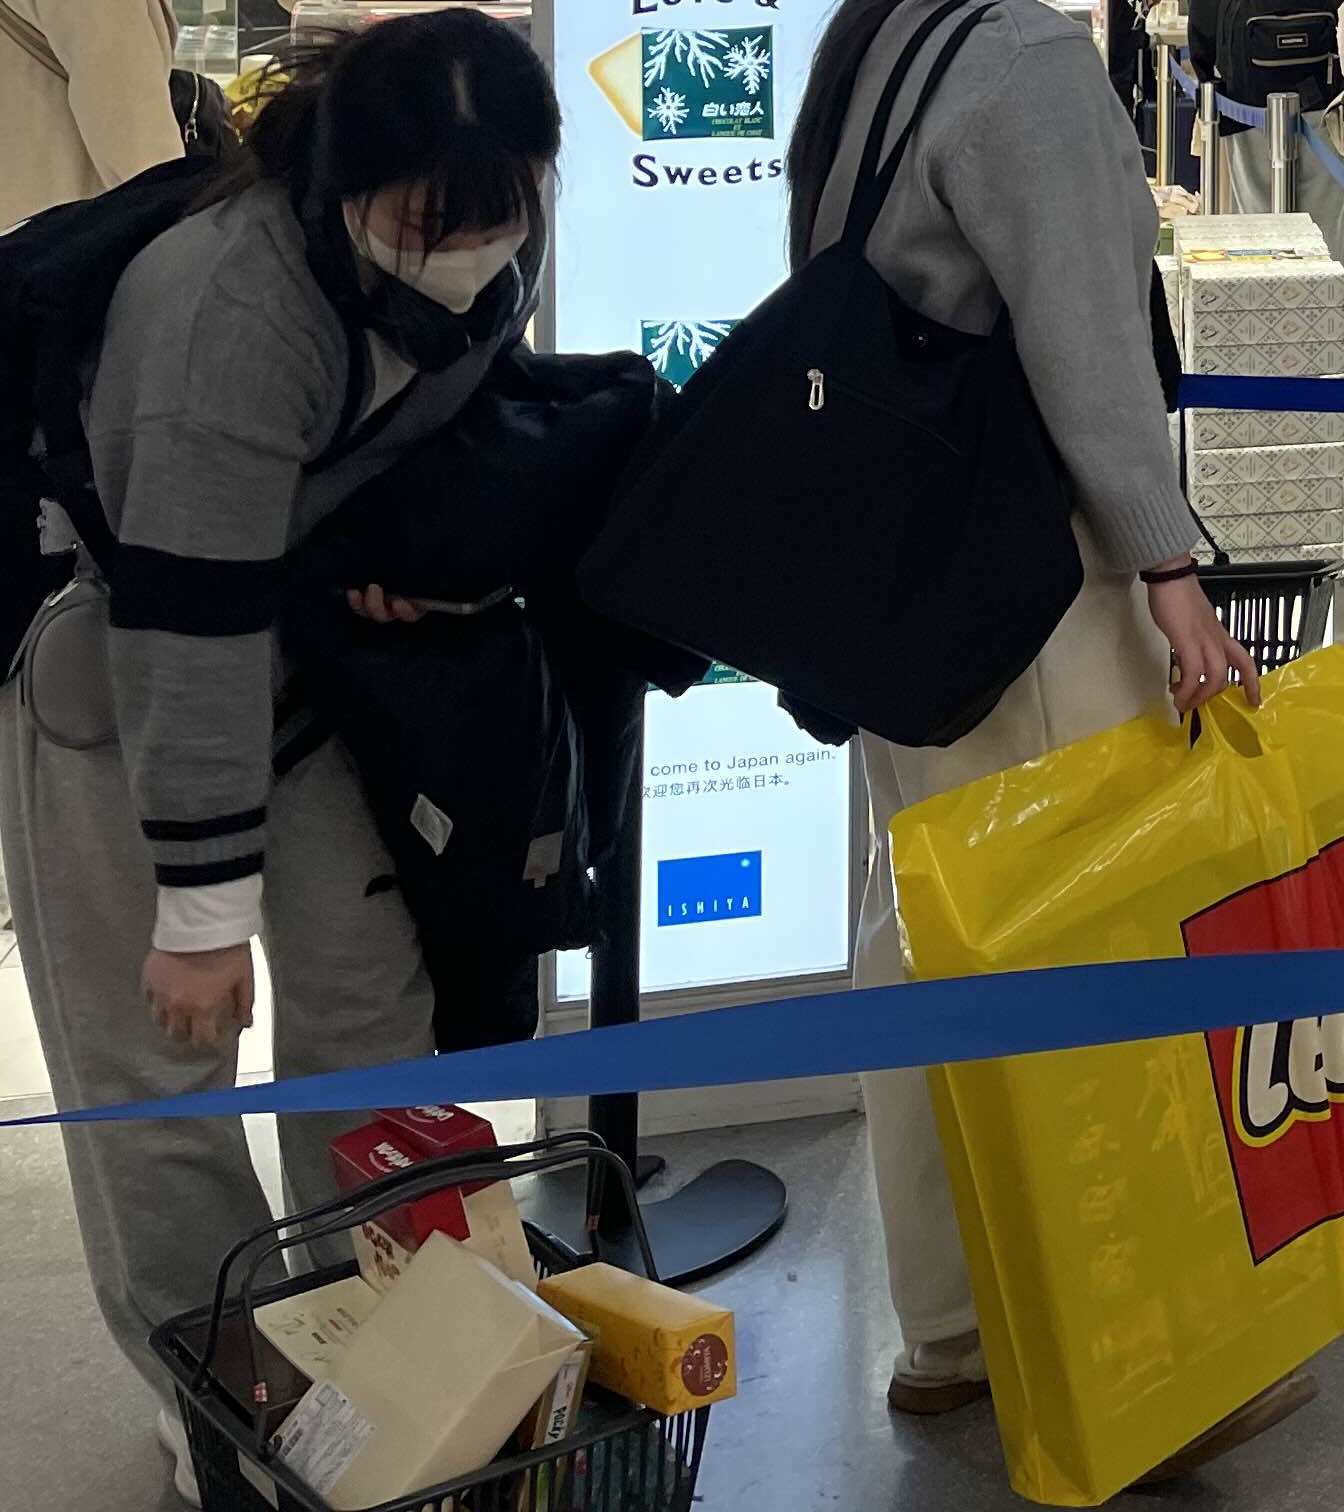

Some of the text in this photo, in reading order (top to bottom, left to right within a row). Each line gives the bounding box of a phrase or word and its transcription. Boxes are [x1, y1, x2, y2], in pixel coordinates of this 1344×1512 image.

[702, 101, 764, 117] 白い恋人
[632, 153, 782, 188] Sweets
[650, 748, 836, 777] come to Japan again.
[668, 896, 750, 918] ISHIYA
